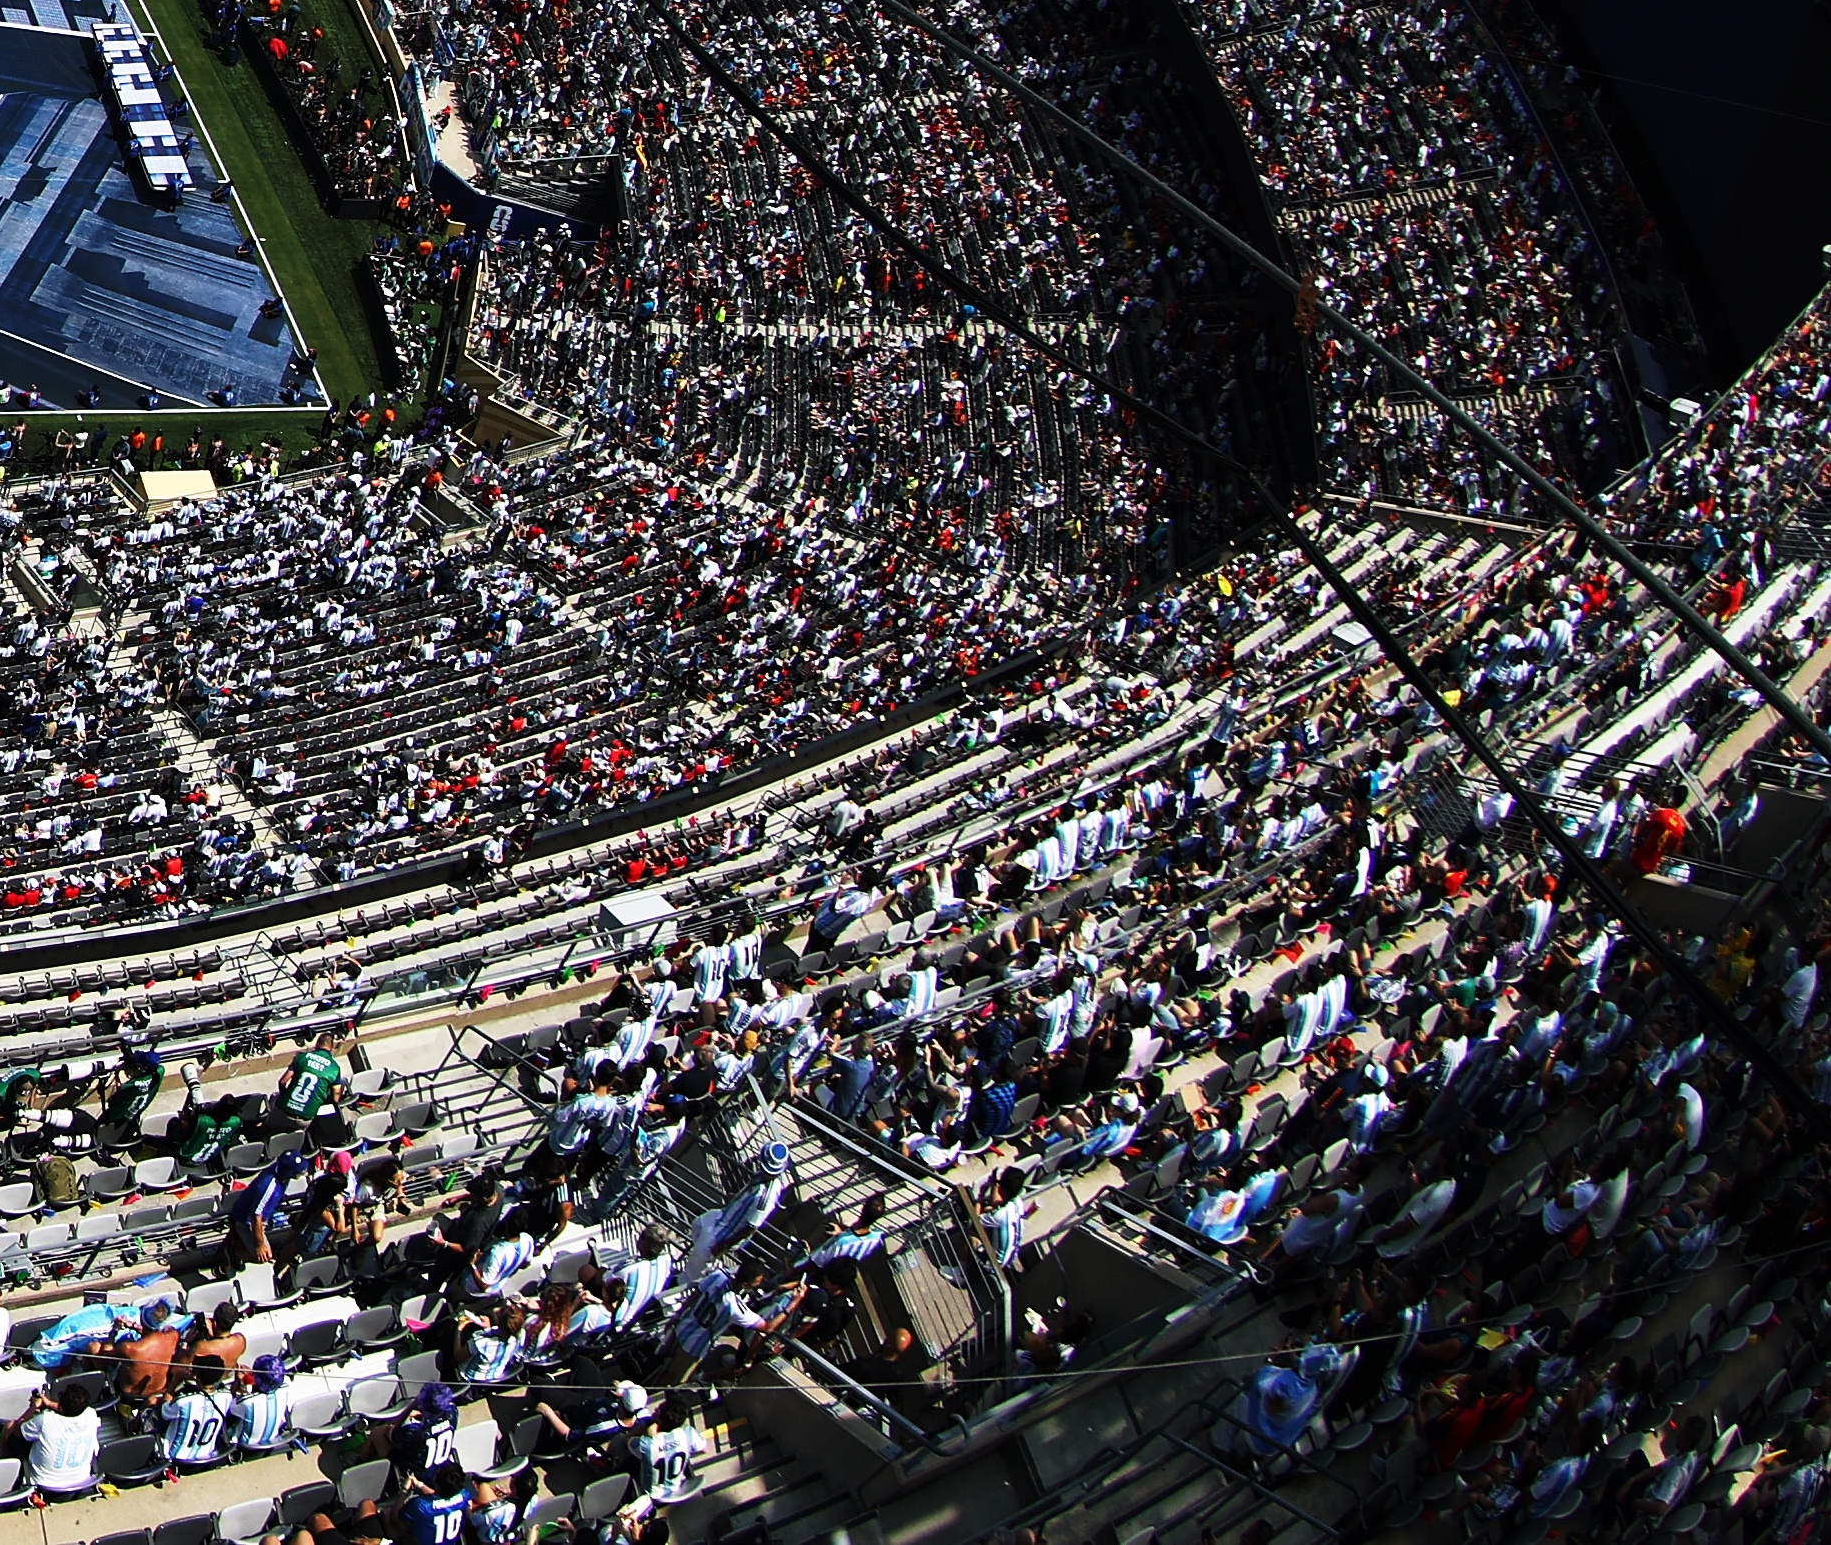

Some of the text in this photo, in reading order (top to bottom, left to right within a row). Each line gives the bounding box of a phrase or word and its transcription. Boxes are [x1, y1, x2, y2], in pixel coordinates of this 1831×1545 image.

[304, 1052, 332, 1063] PHOTO
[189, 1417, 223, 1448] 10
[425, 1430, 454, 1467] 10
[654, 1452, 688, 1485] 10
[431, 1509, 463, 1543] 10
